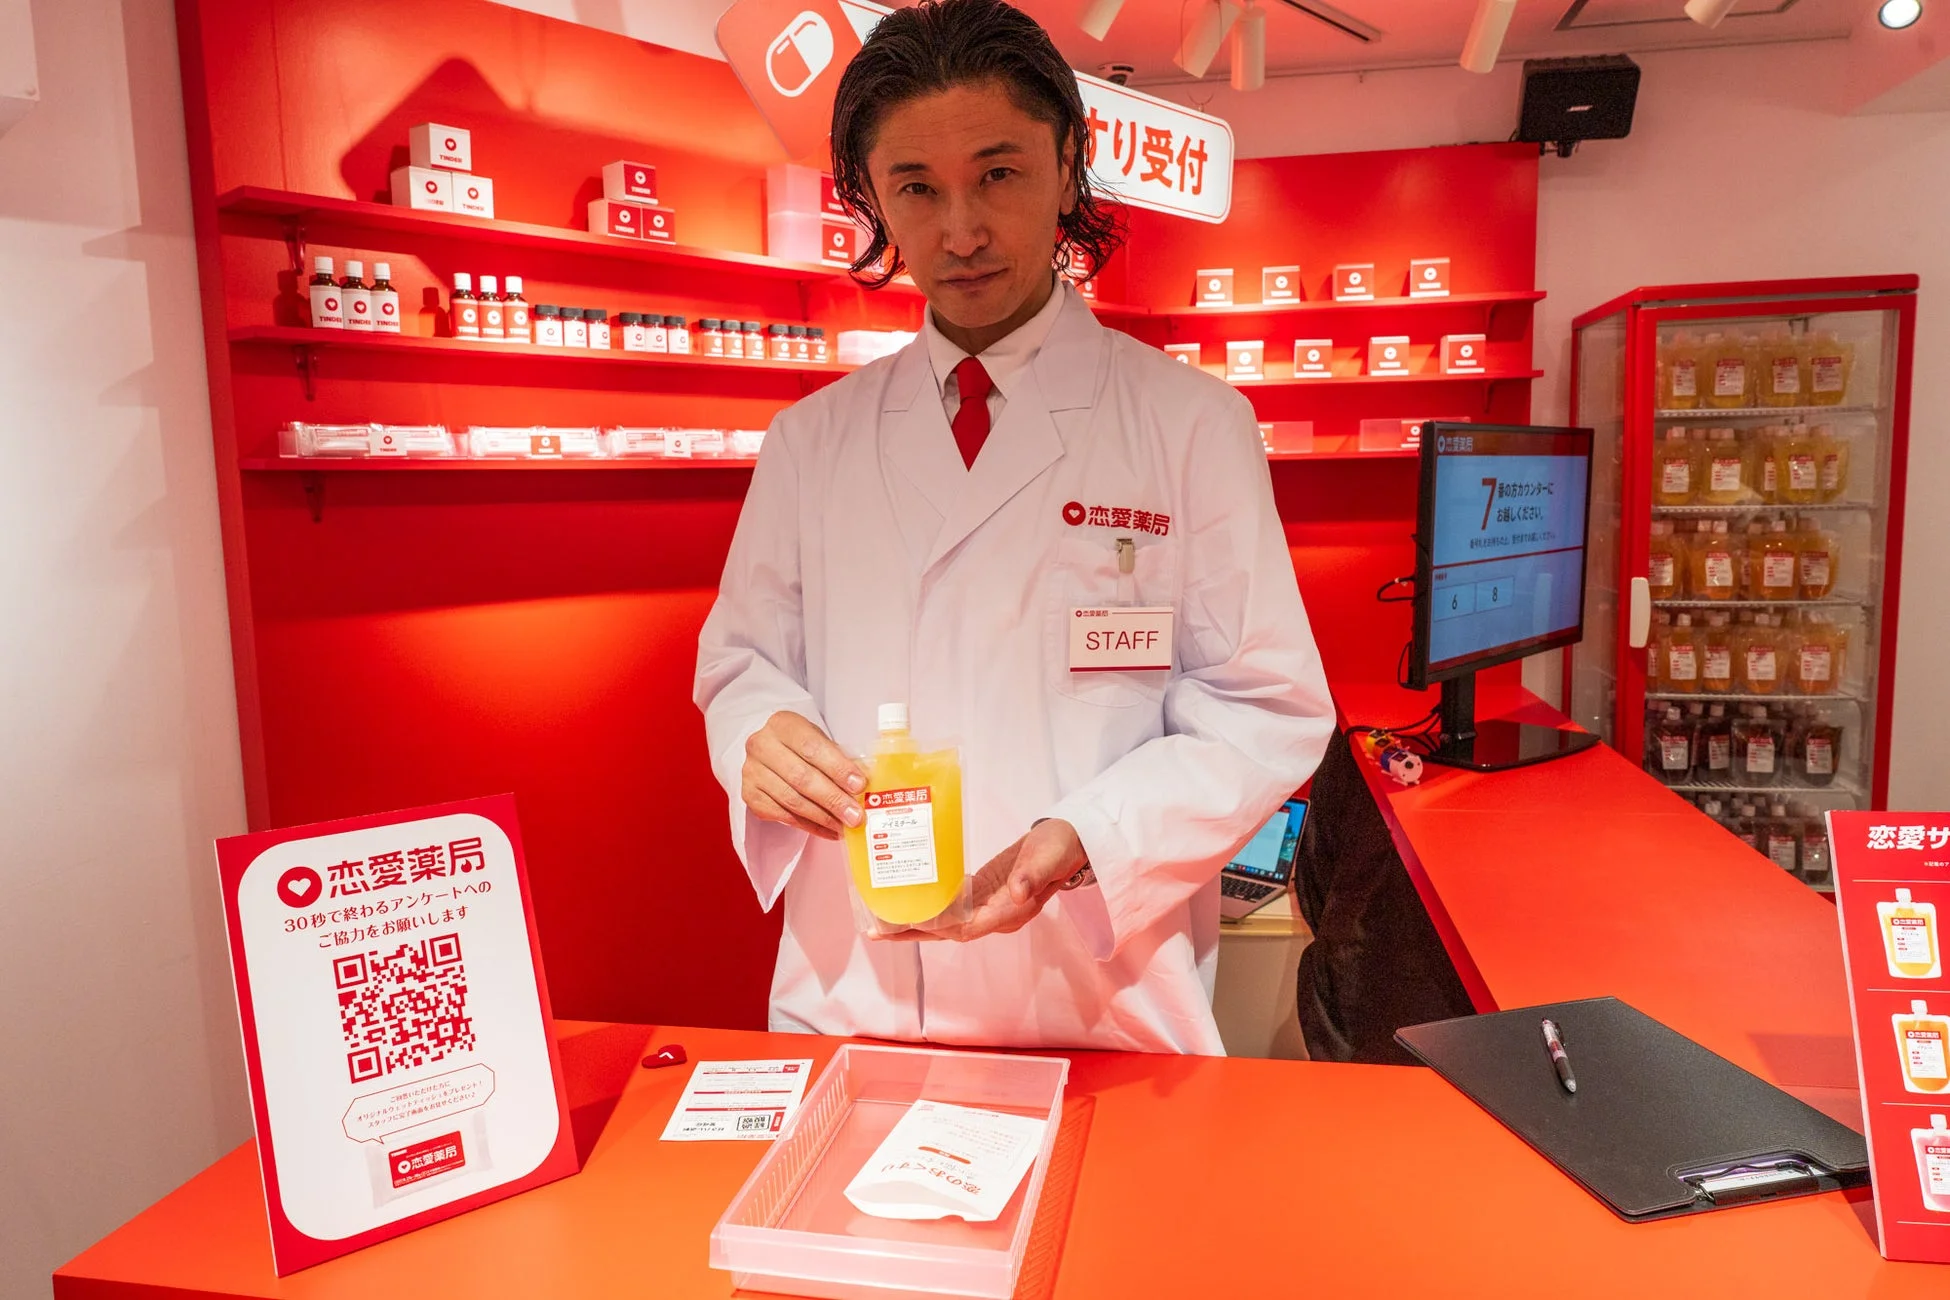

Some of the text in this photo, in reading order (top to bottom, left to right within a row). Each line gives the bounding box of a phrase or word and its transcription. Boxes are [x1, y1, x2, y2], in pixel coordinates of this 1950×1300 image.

[1481, 477, 1498, 531] 7
[1087, 505, 1171, 537] 恋愛薬局
[1452, 593, 1458, 610] 6
[1492, 586, 1498, 602] 8
[1085, 630, 1159, 651] STAFF
[882, 788, 928, 805] 恋愛薬局
[1866, 824, 1950, 851] 恋愛サ
[327, 836, 486, 899] 恋愛薬局
[283, 880, 492, 933] 30秒で終わるアンケートへの
[318, 905, 470, 949] ご協力をお願いします
[411, 1144, 458, 1170] 恋愛薬局
